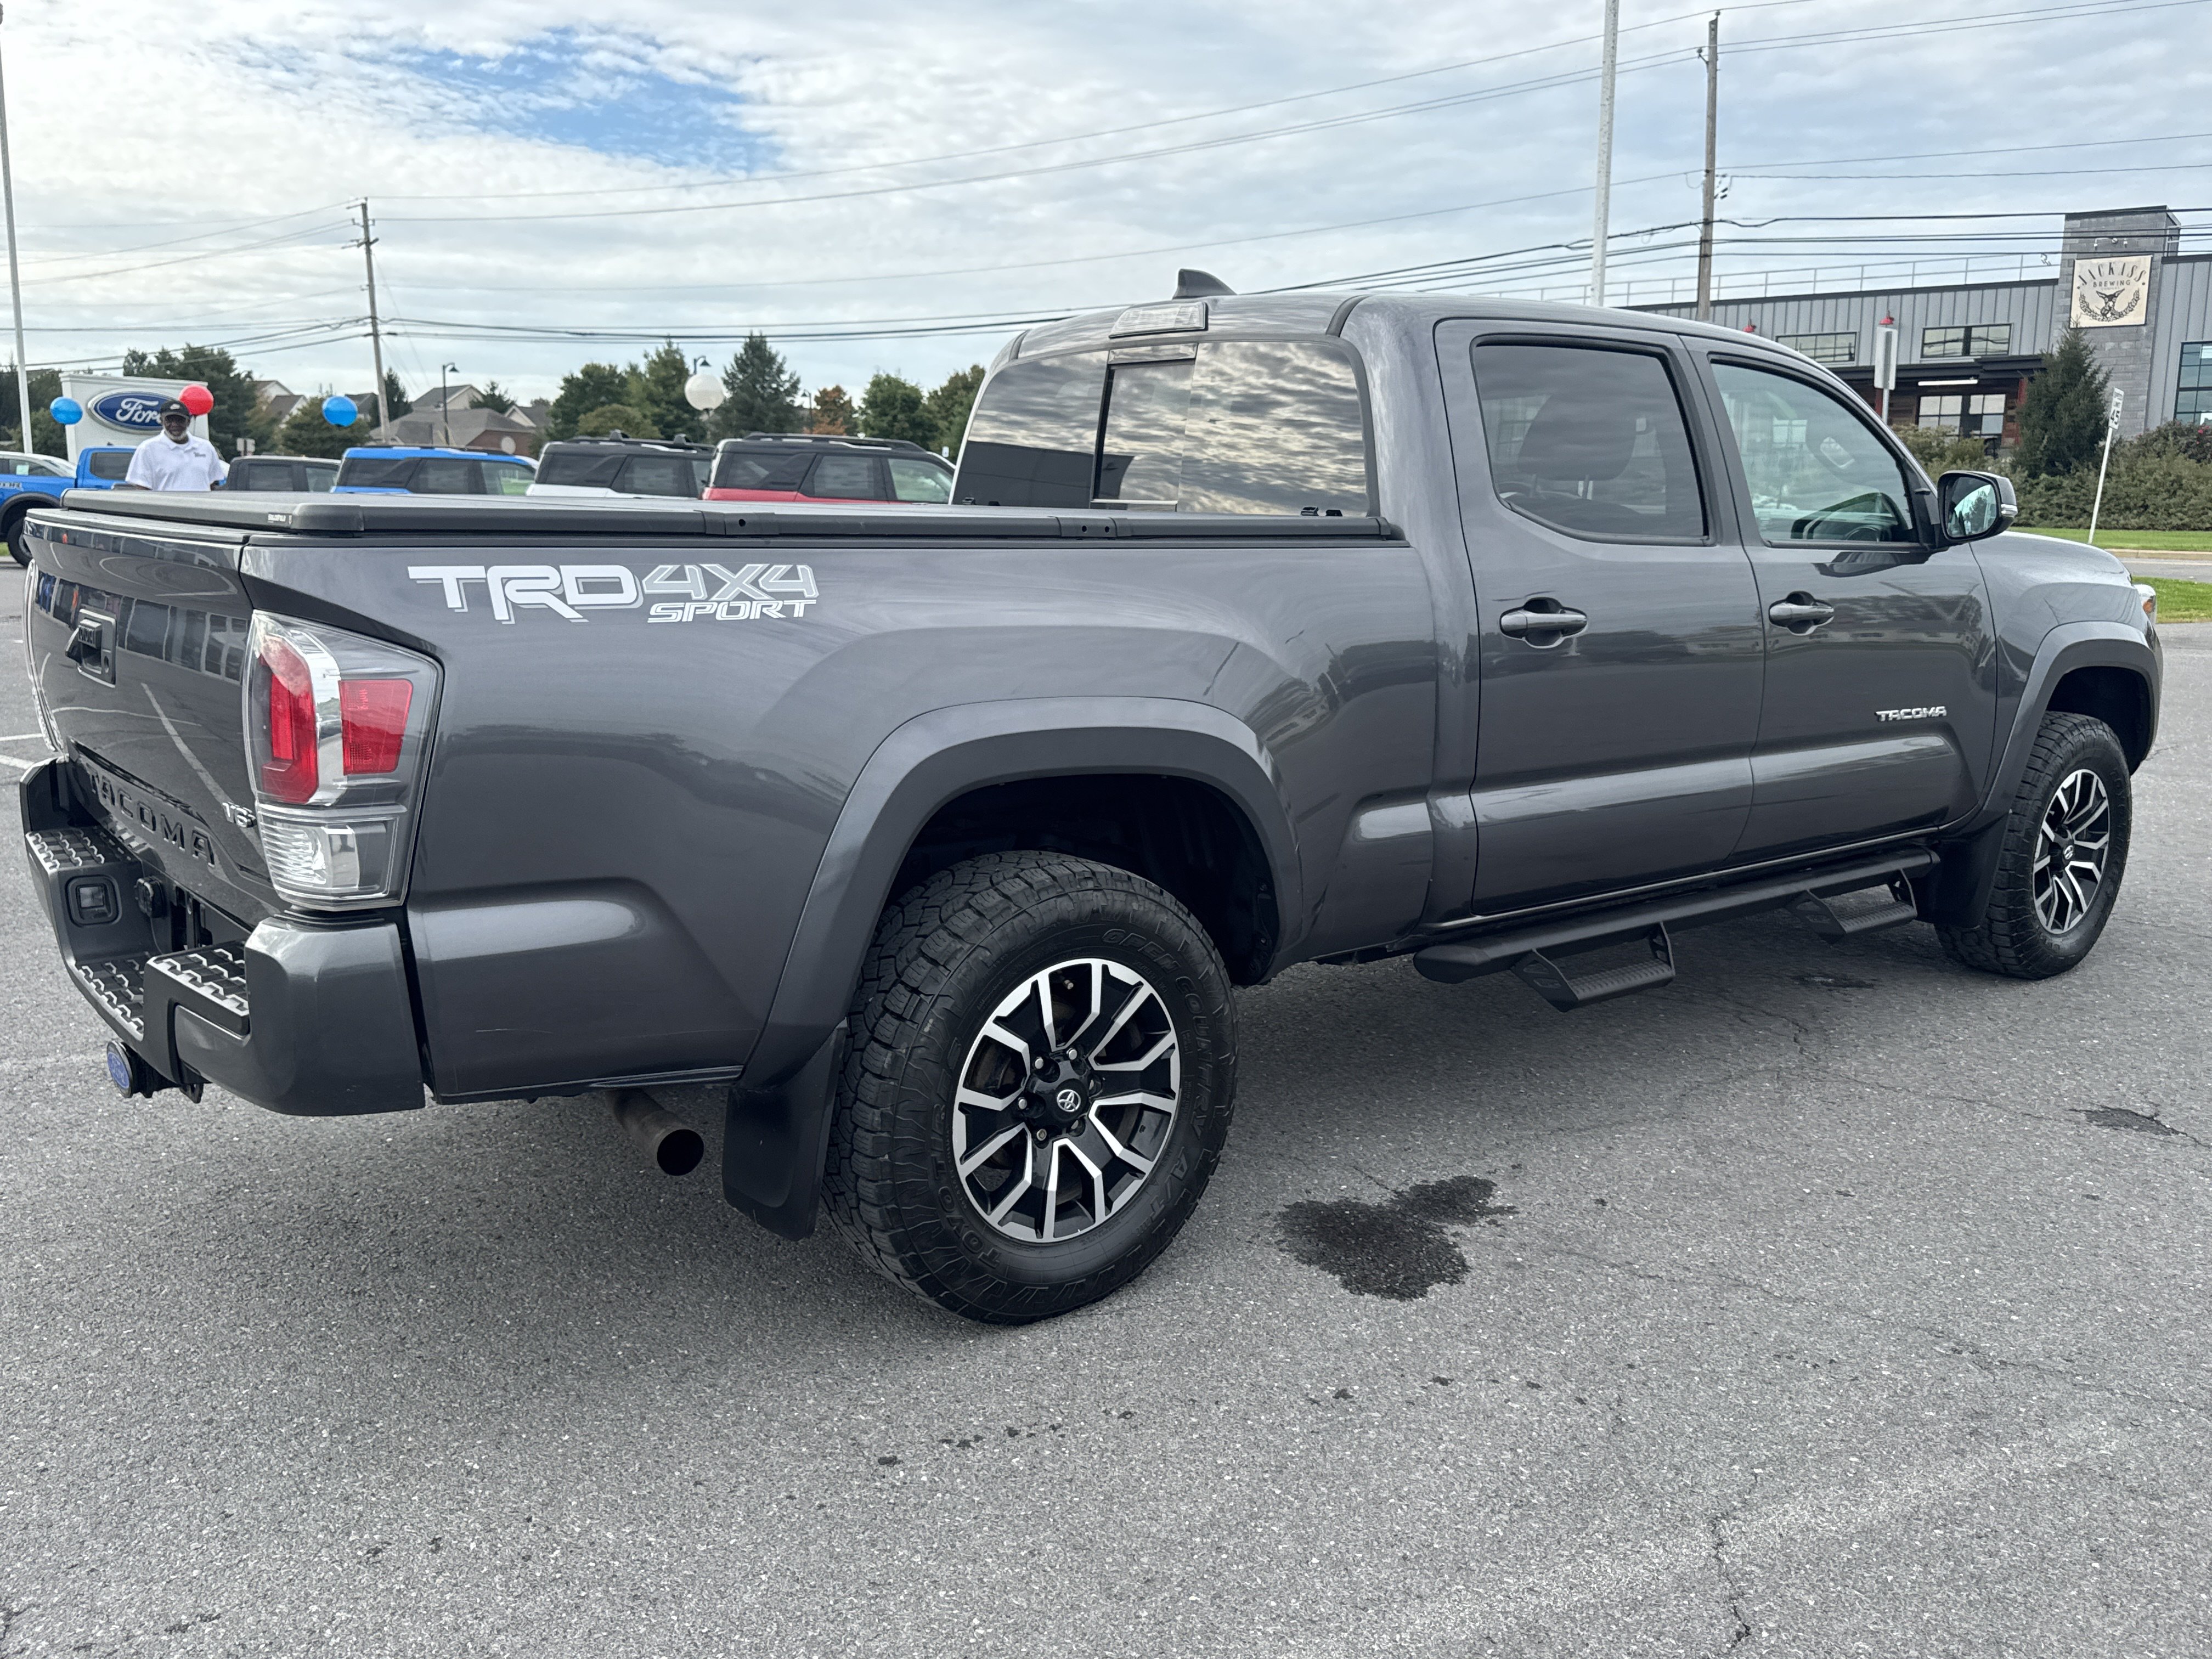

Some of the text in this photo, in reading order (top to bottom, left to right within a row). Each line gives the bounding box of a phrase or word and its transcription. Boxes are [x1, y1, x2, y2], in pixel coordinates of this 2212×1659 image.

[2093, 279, 2131, 287] BREWING
[2111, 409, 2120, 425] 45
[408, 565, 644, 625] TRD
[647, 600, 817, 623] SPORT
[1875, 706, 1947, 722] TACOMA
[84, 763, 216, 868] TACOMA
[1102, 928, 1181, 974] OPEN
[1175, 975, 1214, 1140] COUNTRY
[938, 1186, 1001, 1269] TOYO
